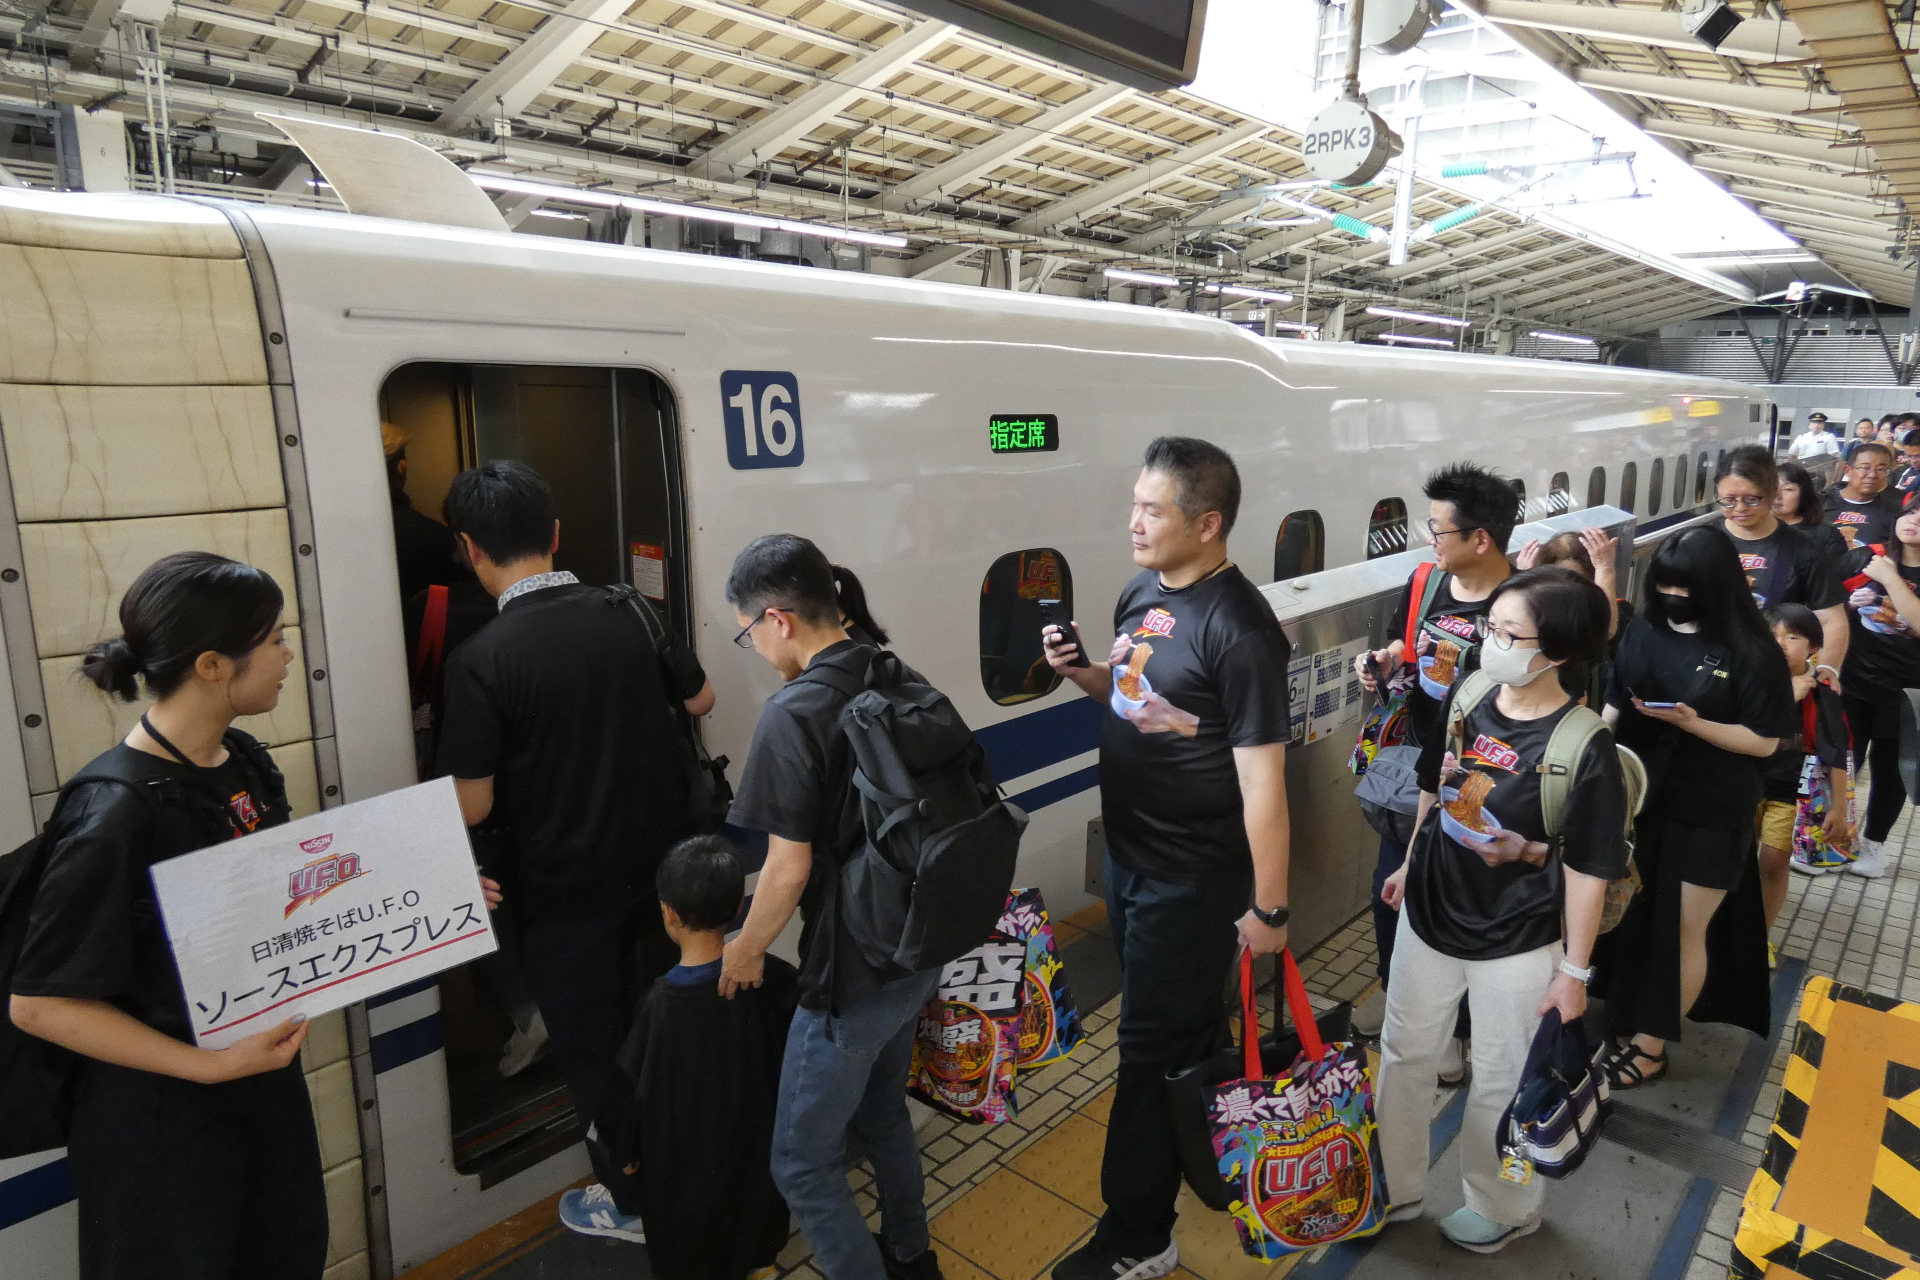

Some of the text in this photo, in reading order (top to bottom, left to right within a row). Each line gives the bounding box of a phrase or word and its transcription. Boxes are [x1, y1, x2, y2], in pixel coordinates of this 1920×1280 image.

[1304, 126, 1371, 155] 2RPK3
[729, 383, 796, 457] 16
[989, 418, 1046, 450] 指定席
[303, 836, 331, 850] NISSIN
[251, 890, 420, 963] 日清焼そばU.F.O
[196, 902, 482, 1024] ソースエクスプレス
